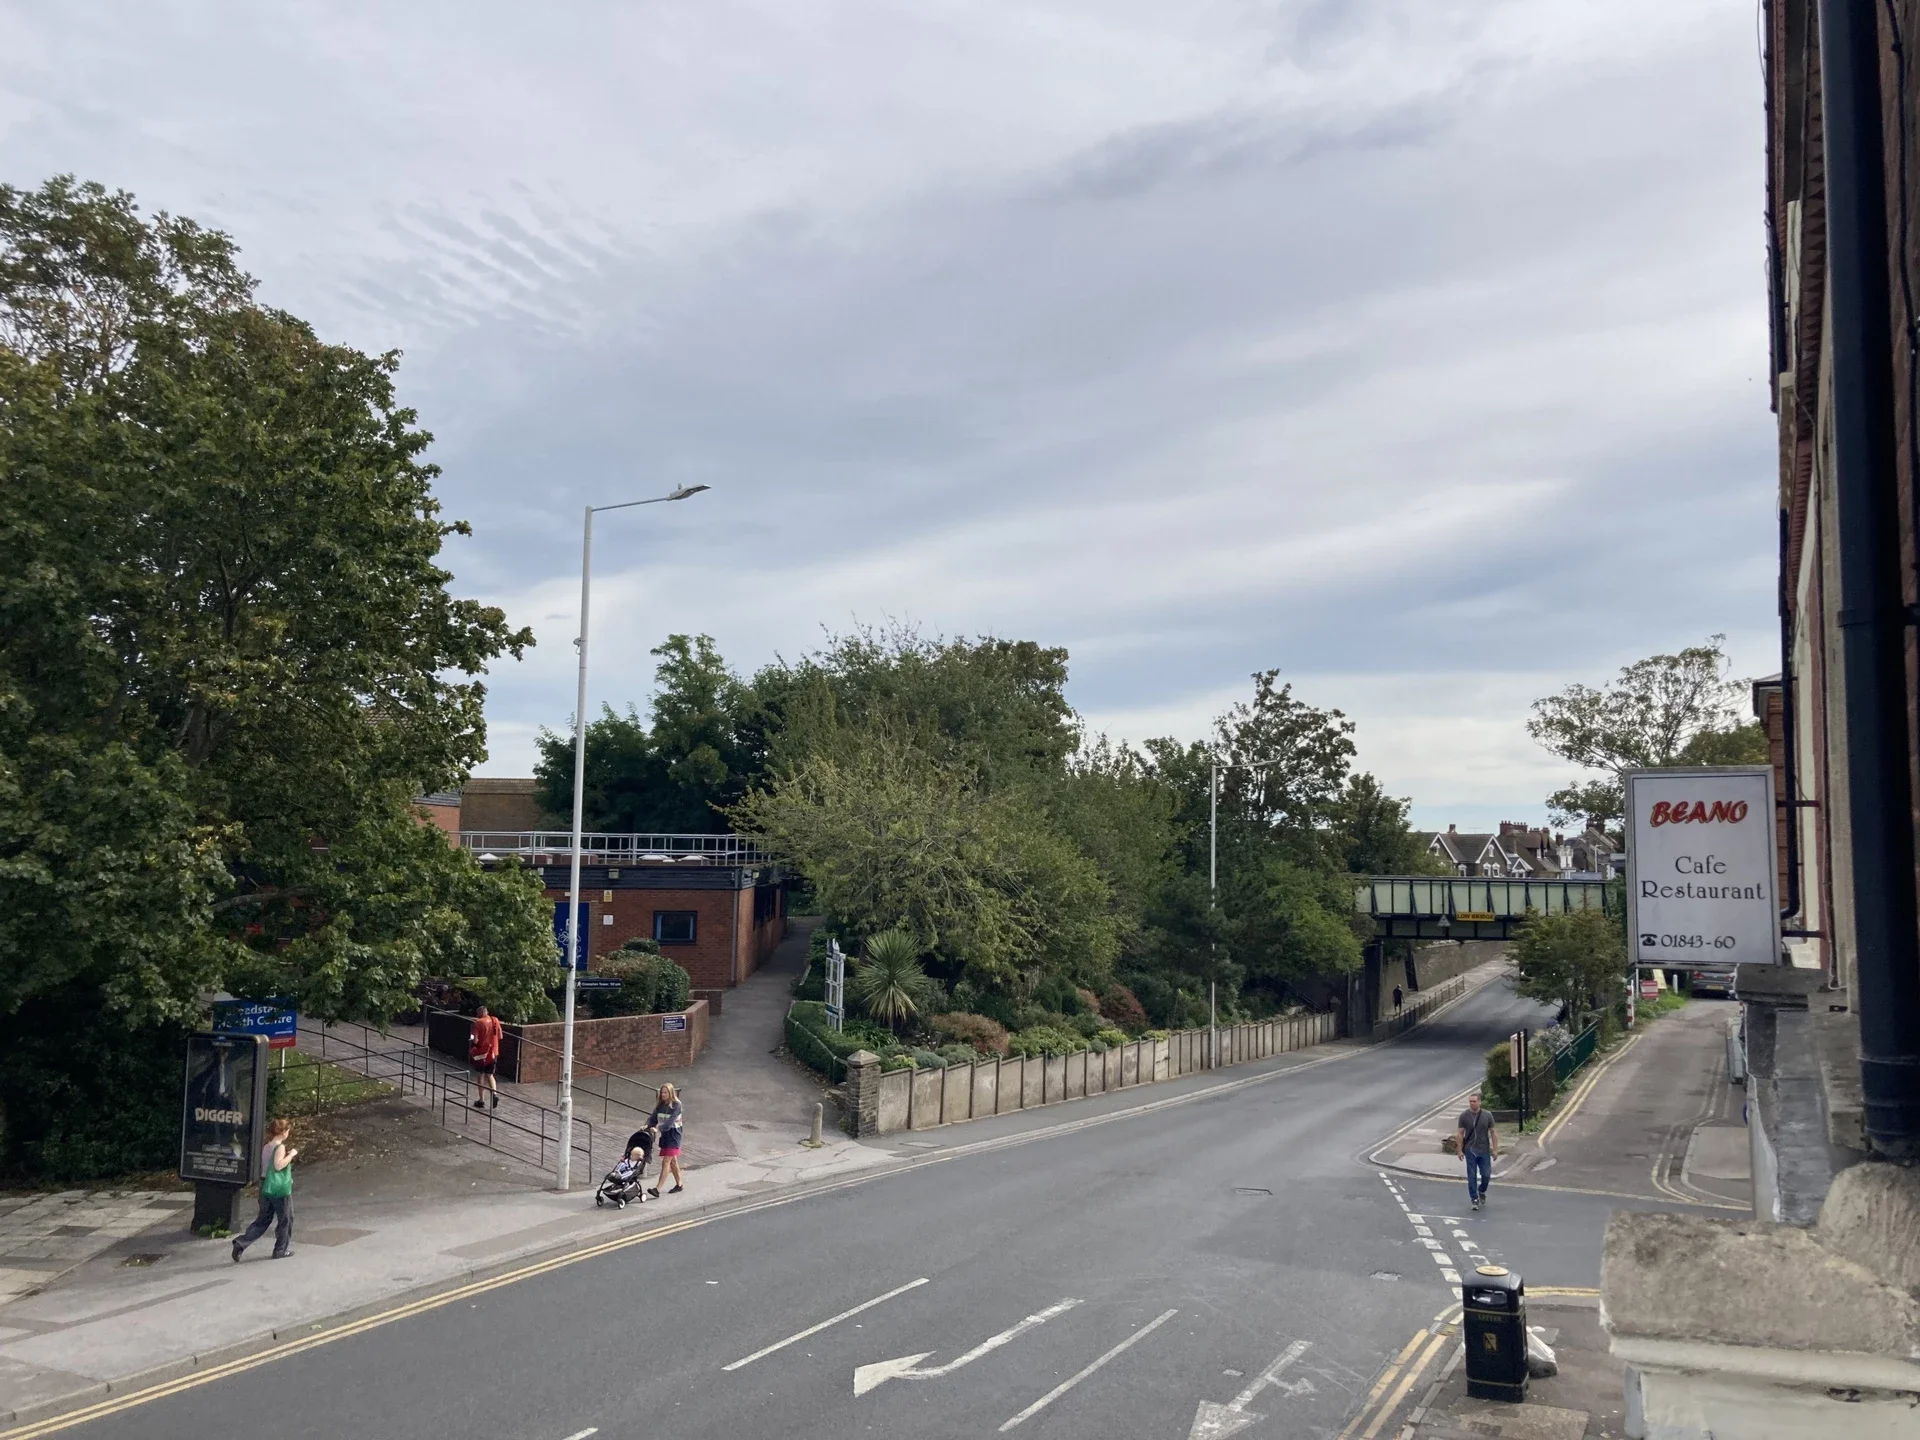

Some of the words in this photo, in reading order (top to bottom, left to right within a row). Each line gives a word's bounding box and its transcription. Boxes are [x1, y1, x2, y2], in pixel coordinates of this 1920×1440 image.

[1650, 800, 1749, 828] BEANO
[1675, 854, 1726, 874] Cafe
[1640, 880, 1766, 900] Restaurant
[195, 1107, 243, 1125] DIGGER
